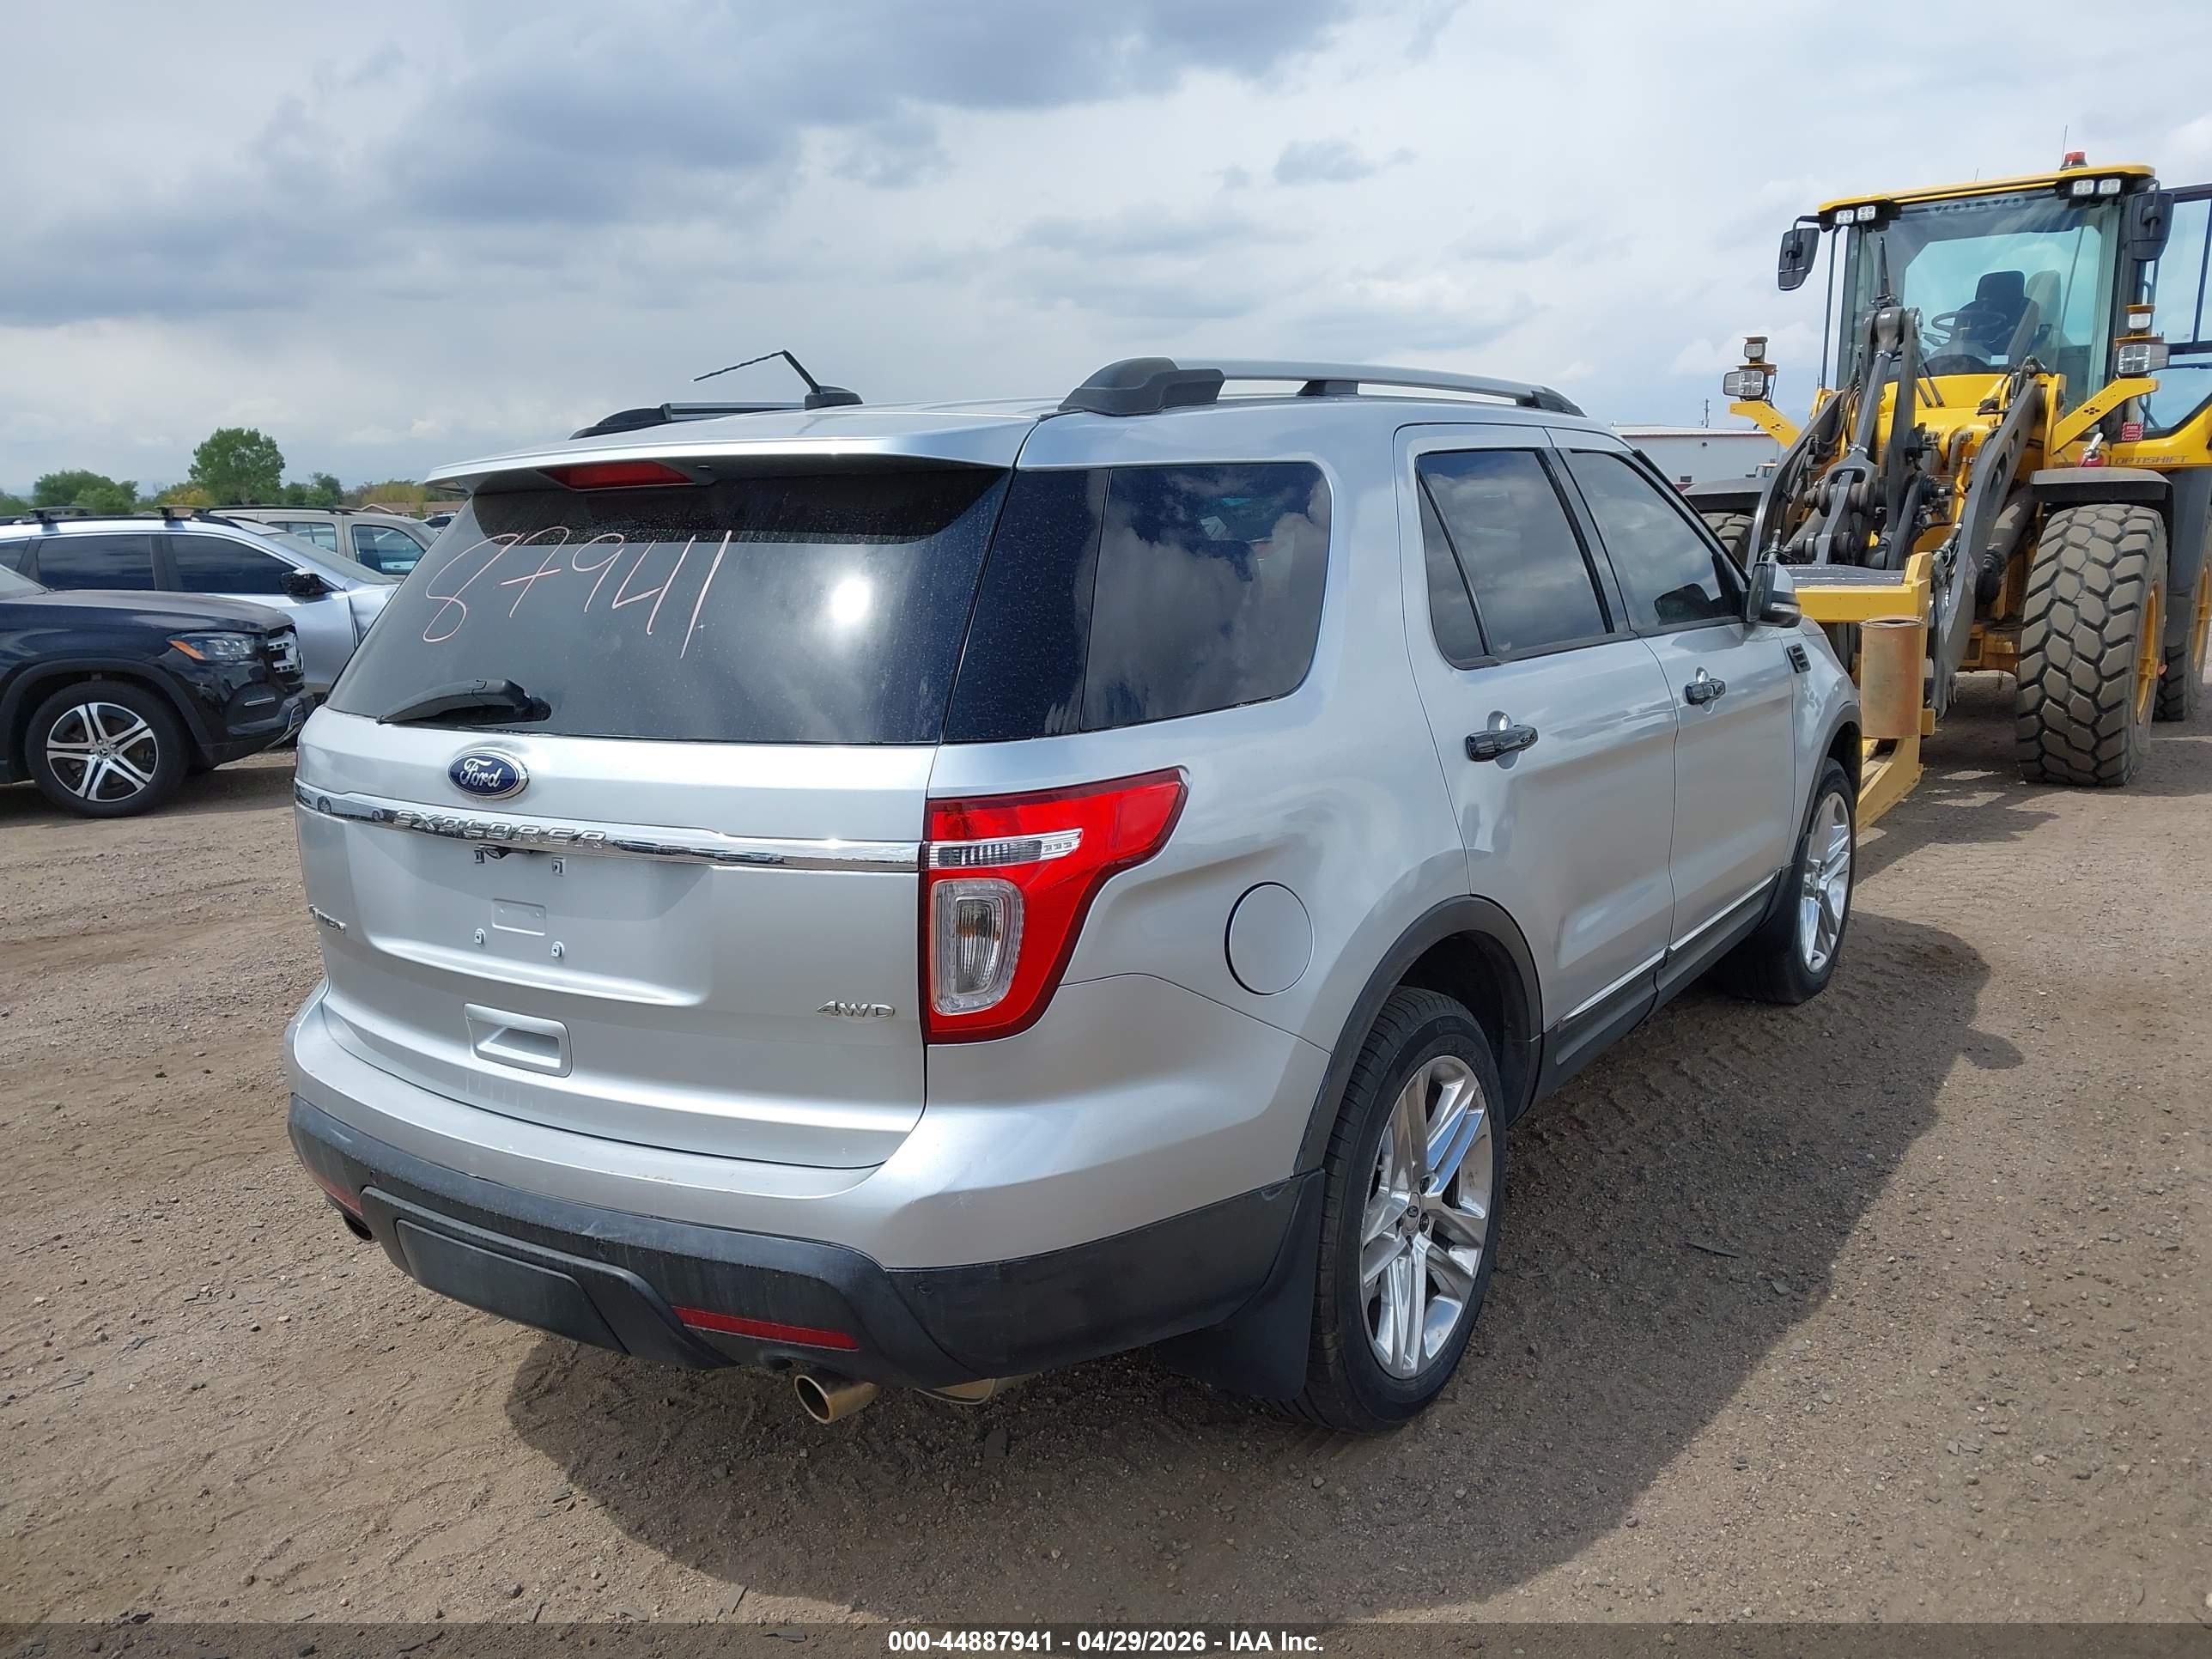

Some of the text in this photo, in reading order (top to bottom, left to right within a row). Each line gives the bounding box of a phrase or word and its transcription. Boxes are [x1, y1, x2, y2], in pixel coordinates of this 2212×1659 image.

[2114, 455, 2189, 465] OPTISHIFT
[422, 526, 733, 660] 87941
[459, 757, 503, 788] Ford
[392, 809, 606, 848] EXPLORER
[817, 1000, 896, 1018] 4WD
